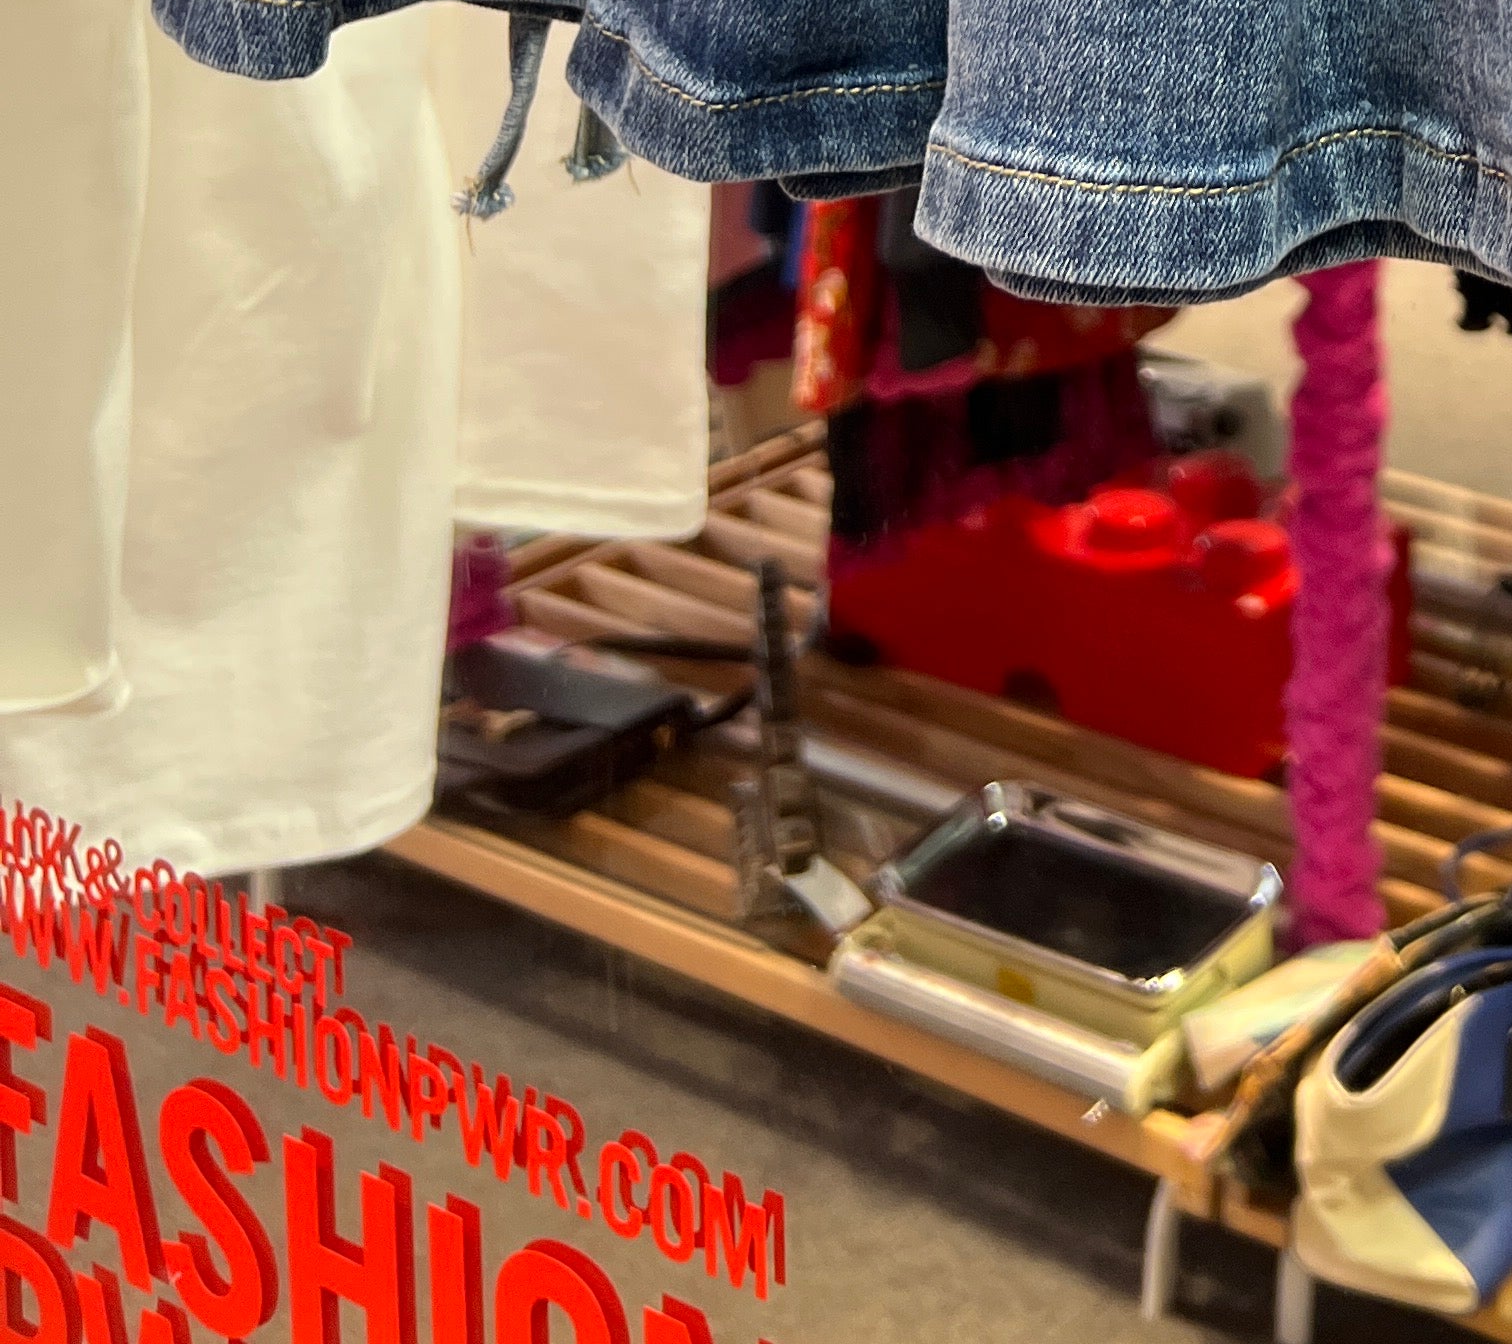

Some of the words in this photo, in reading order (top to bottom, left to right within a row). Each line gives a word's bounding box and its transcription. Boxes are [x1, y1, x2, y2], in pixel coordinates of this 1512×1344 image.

[85, 847, 115, 915] &
[134, 867, 335, 1009] COLLECT
[0, 862, 768, 1300] WW.FASHIONPWR.COM
